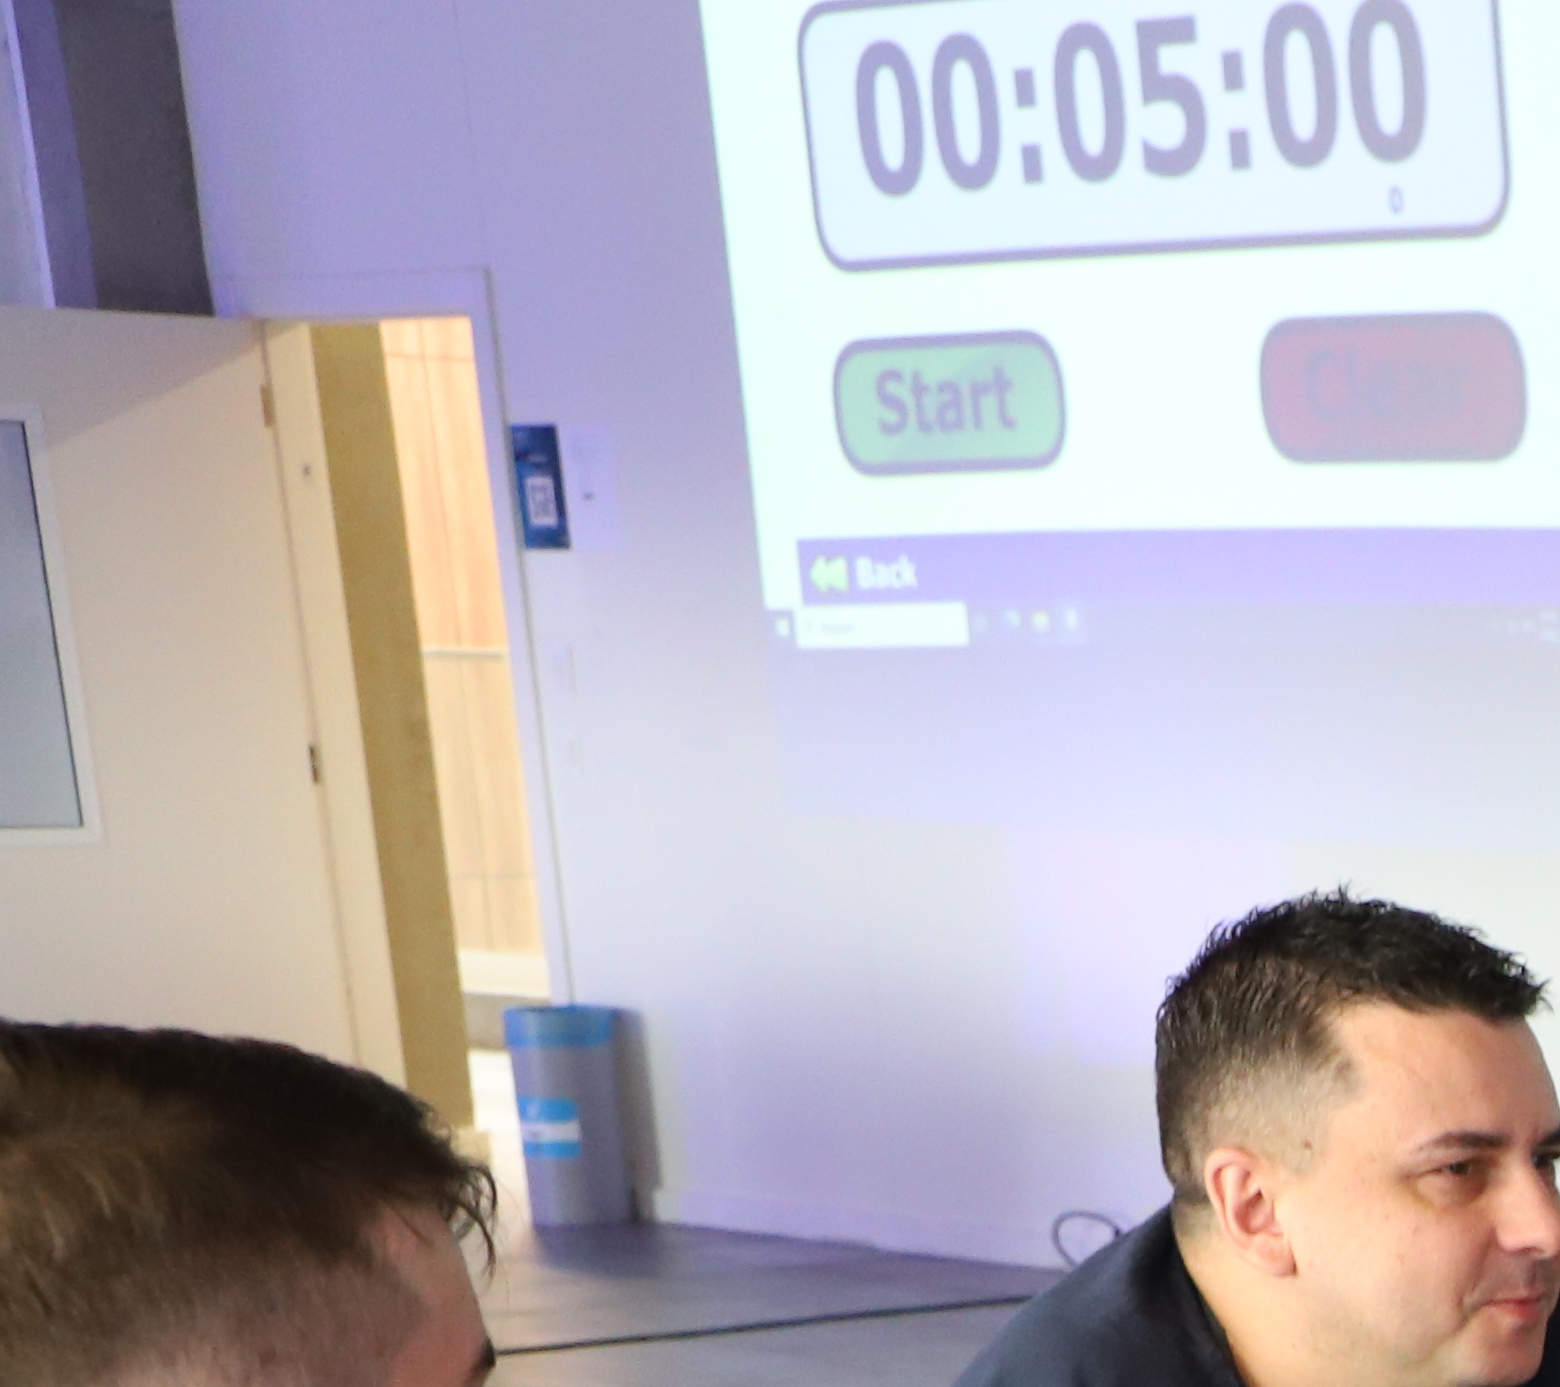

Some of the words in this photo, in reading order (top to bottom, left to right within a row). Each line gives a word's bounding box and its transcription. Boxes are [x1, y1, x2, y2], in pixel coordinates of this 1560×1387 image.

[854, 0, 1428, 197] 00:05:00
[874, 363, 1018, 437] Start
[854, 554, 919, 589] Back
